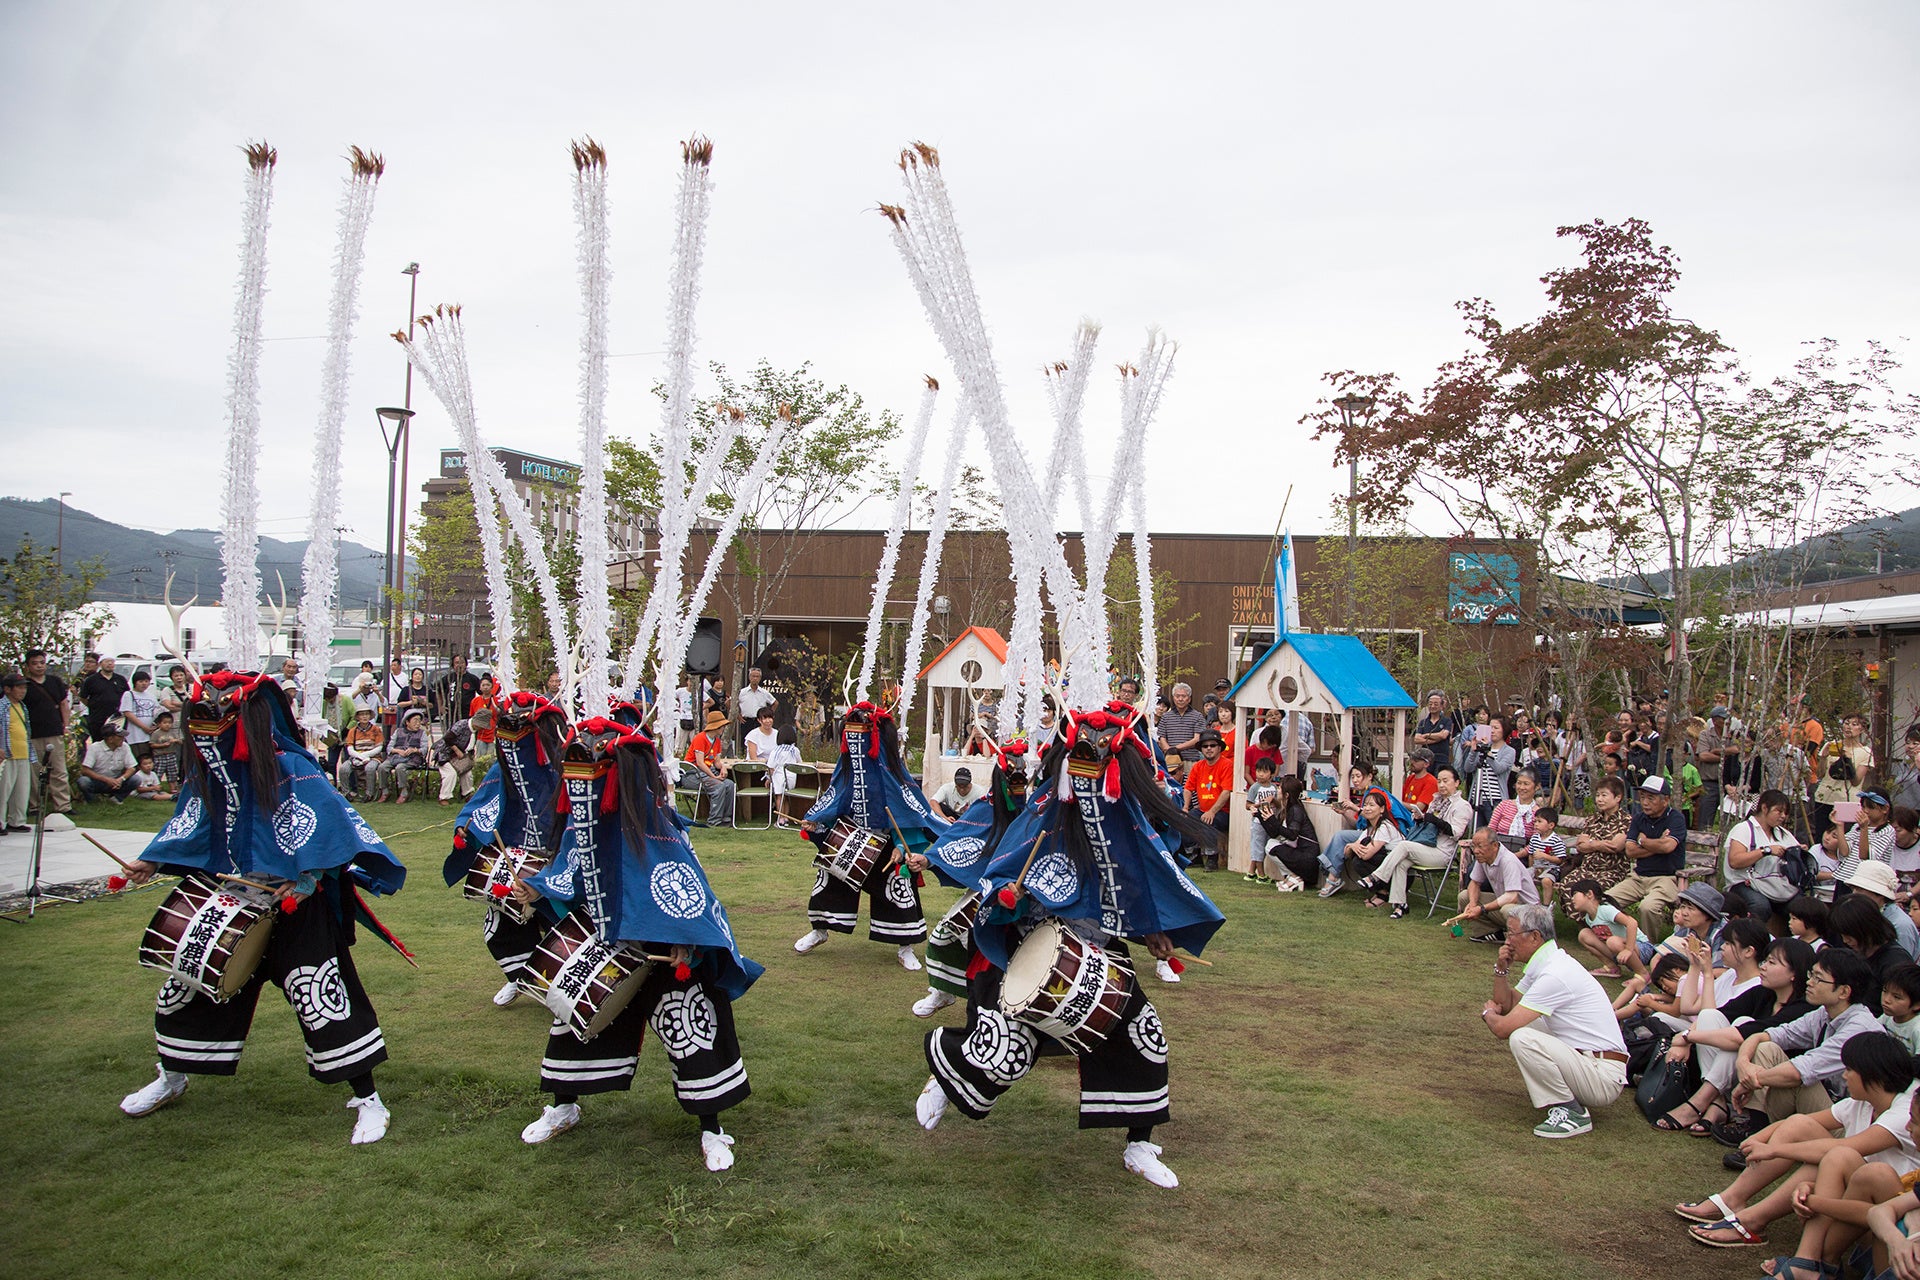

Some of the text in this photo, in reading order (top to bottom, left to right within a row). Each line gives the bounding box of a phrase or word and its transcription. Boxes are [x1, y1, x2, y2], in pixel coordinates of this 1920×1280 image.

[521, 460, 553, 481] HOTEL
[1232, 611, 1273, 624] ZAKKAT
[967, 643, 977, 657] 2
[178, 906, 229, 979] 笹崎鹿踊
[1055, 954, 1105, 1028] 笹崎鹿踊
